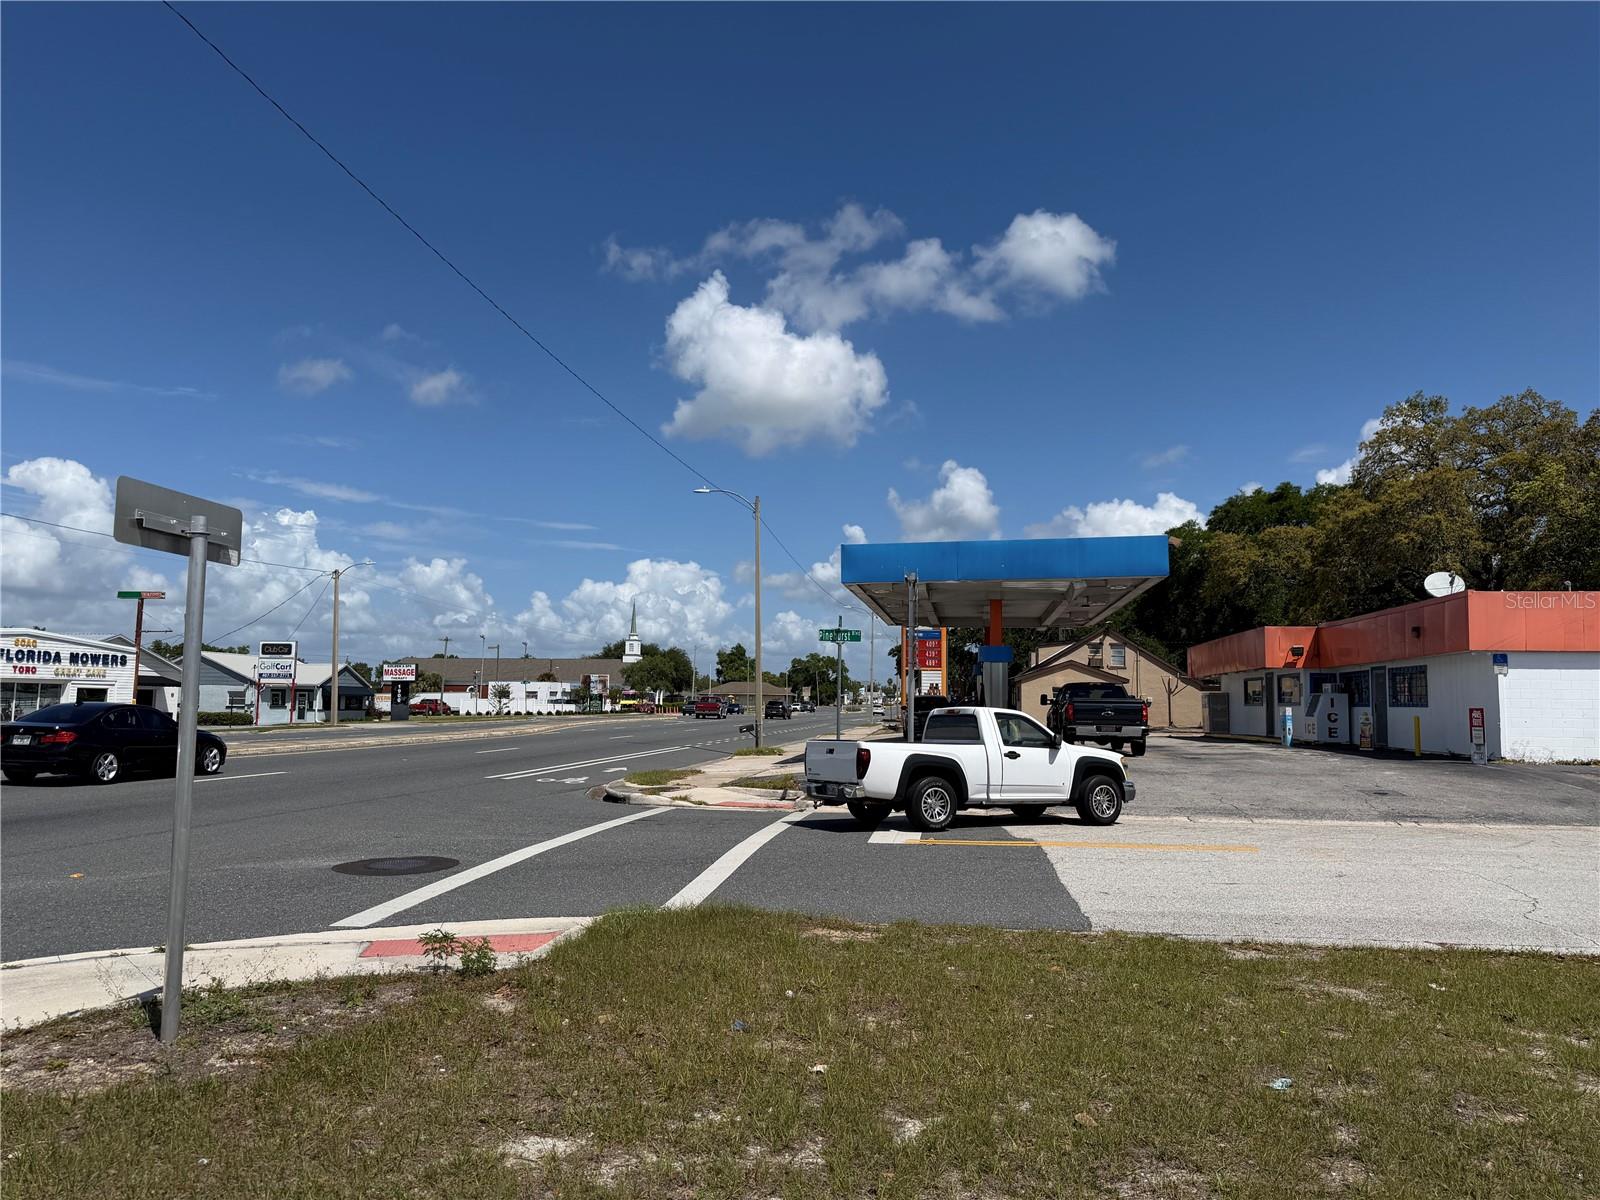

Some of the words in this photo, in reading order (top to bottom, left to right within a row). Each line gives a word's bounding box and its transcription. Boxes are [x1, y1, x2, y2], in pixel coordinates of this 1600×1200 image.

[0, 648, 61, 665] FLORIDA
[69, 652, 128, 667] MOWERS
[12, 666, 37, 675] TORO
[384, 668, 415, 677] MASSAGE
[1327, 697, 1339, 739] ICE
[1304, 721, 1317, 735] ICE
